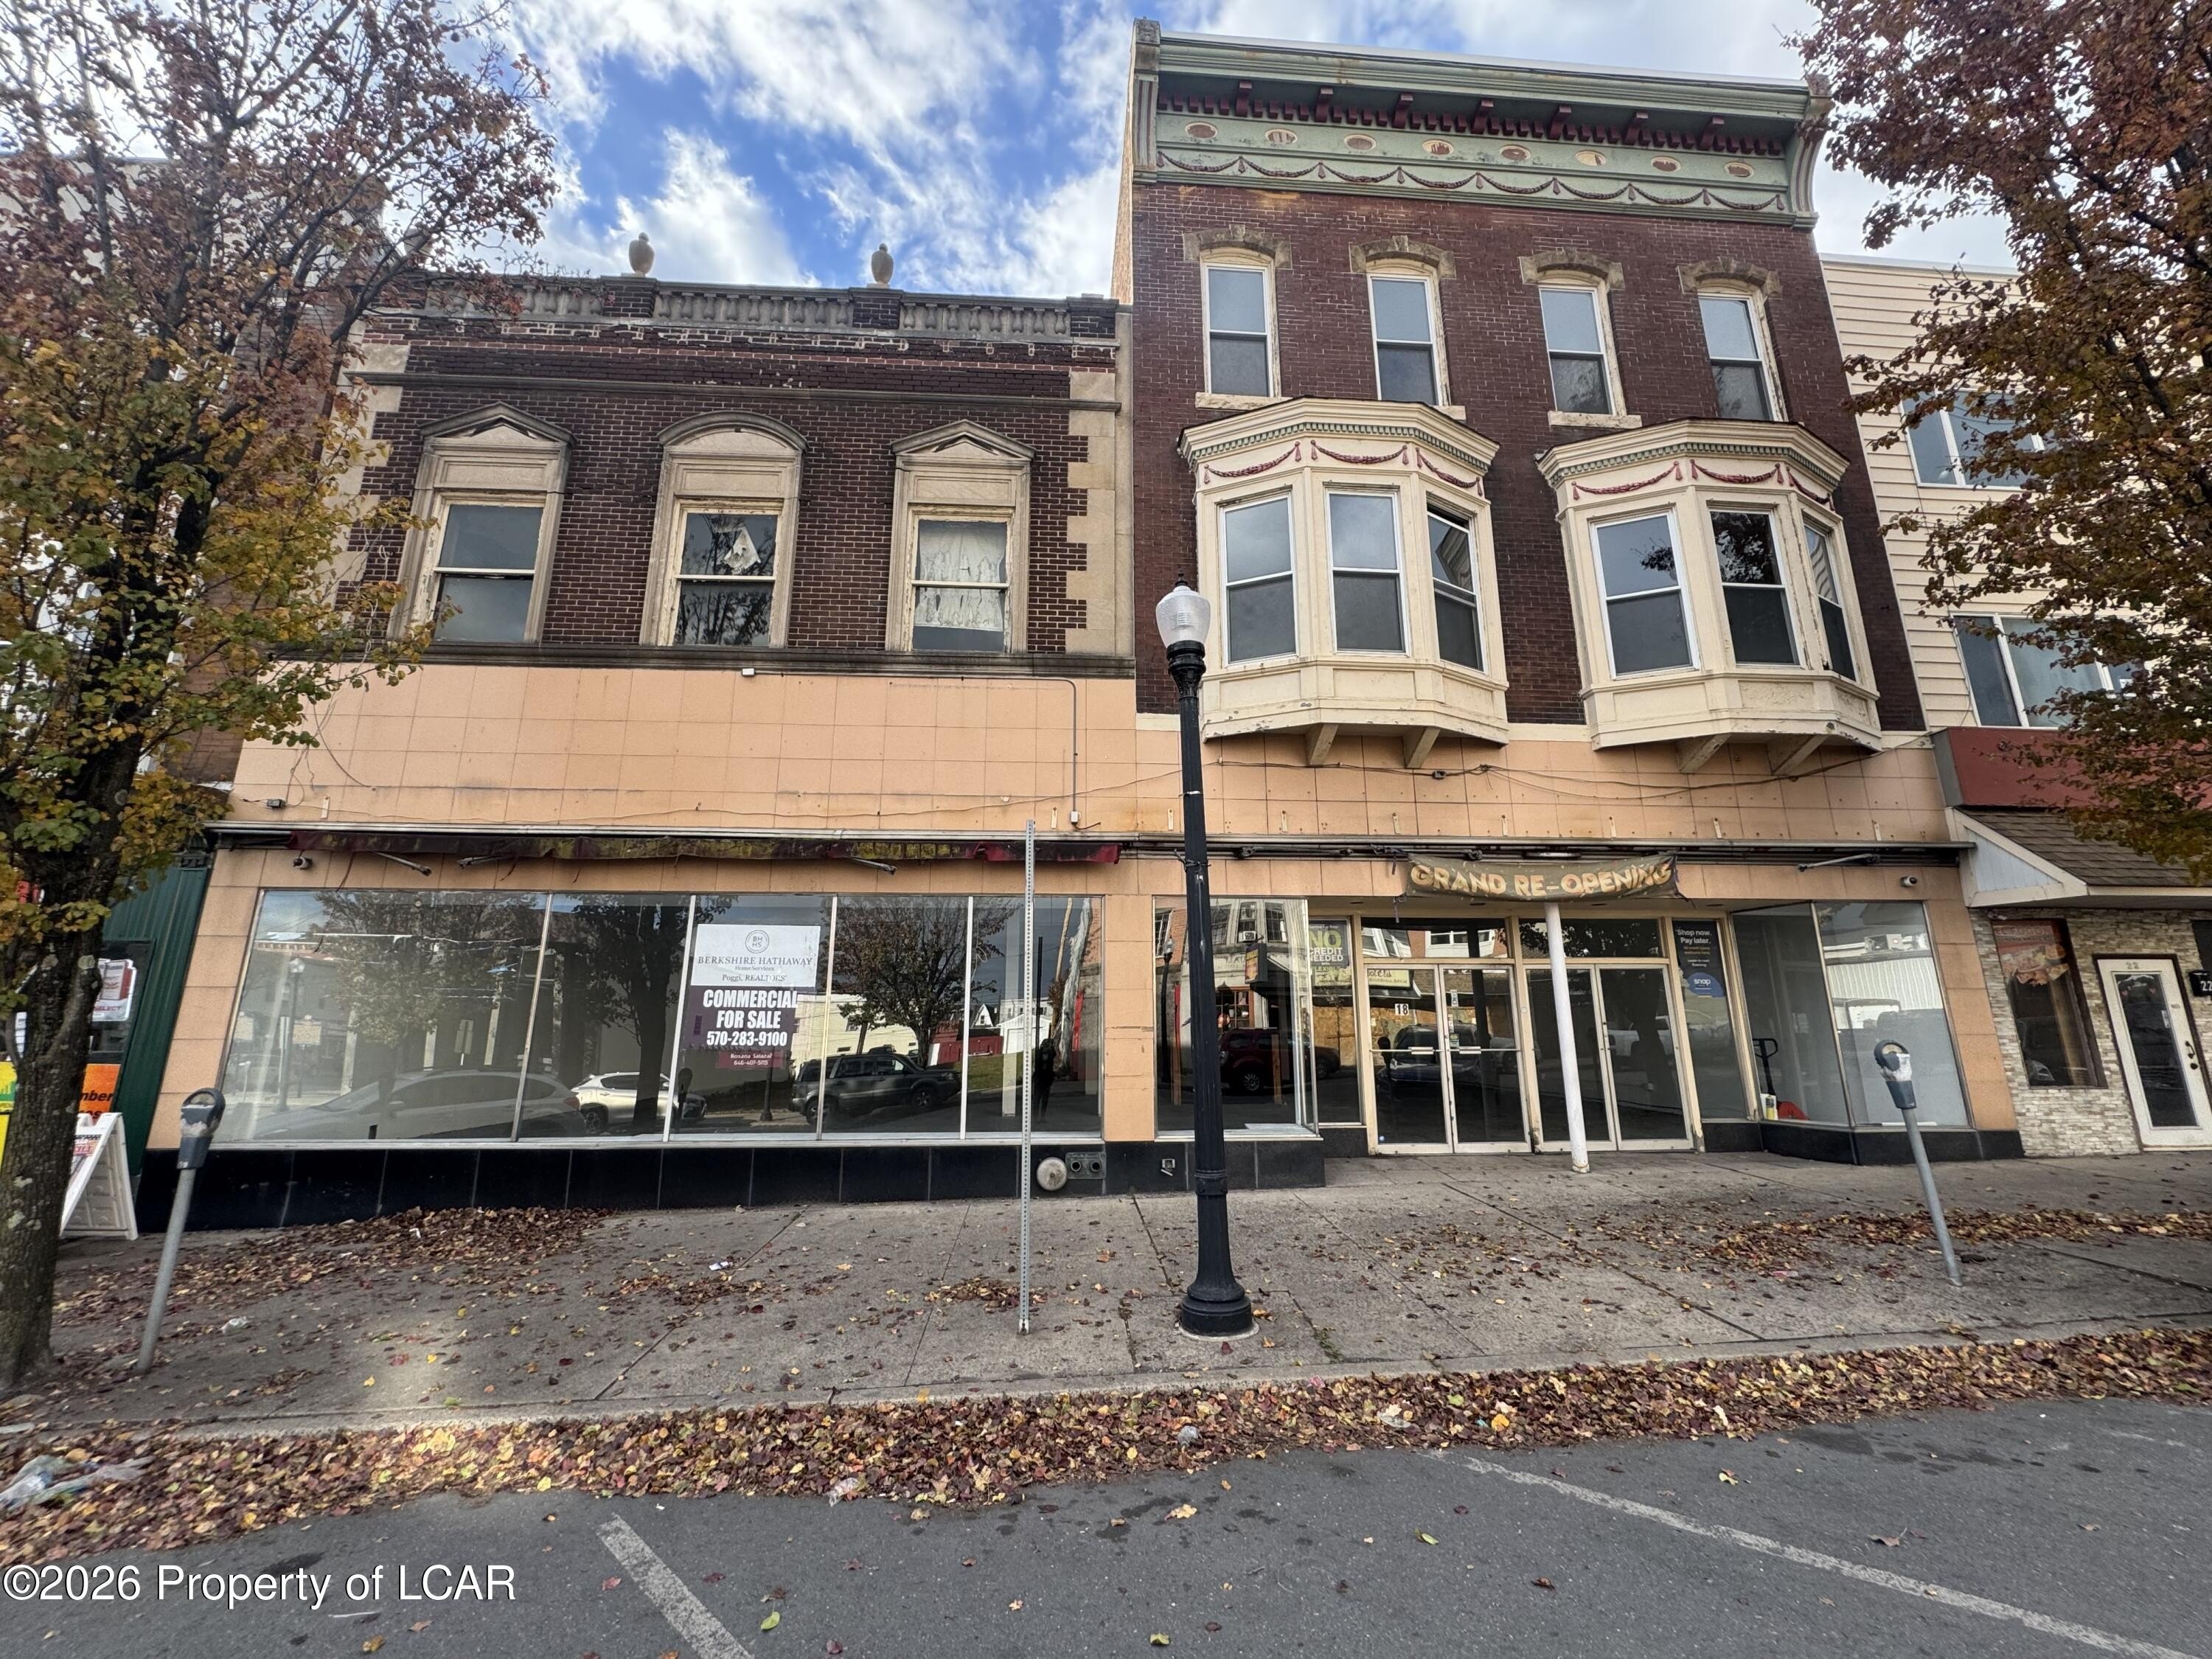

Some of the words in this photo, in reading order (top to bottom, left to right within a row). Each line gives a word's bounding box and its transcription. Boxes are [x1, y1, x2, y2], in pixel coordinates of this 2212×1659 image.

[1411, 864, 1506, 894] GRAND
[1514, 862, 1672, 897] RE-OPENING
[1309, 930, 1342, 948] NO
[1308, 954, 1343, 962] NEEDED
[1309, 947, 1343, 956] CREDIT
[698, 956, 756, 964] BERKSHIRE
[758, 957, 813, 966] HATHAWAY
[1693, 978, 1711, 987] snap
[703, 990, 799, 1009] COMMERCIAL
[1397, 1004, 1408, 1015] 18
[716, 1010, 745, 1029] FOR
[748, 1011, 782, 1029] SALE
[706, 1031, 787, 1046] 570-283-9100
